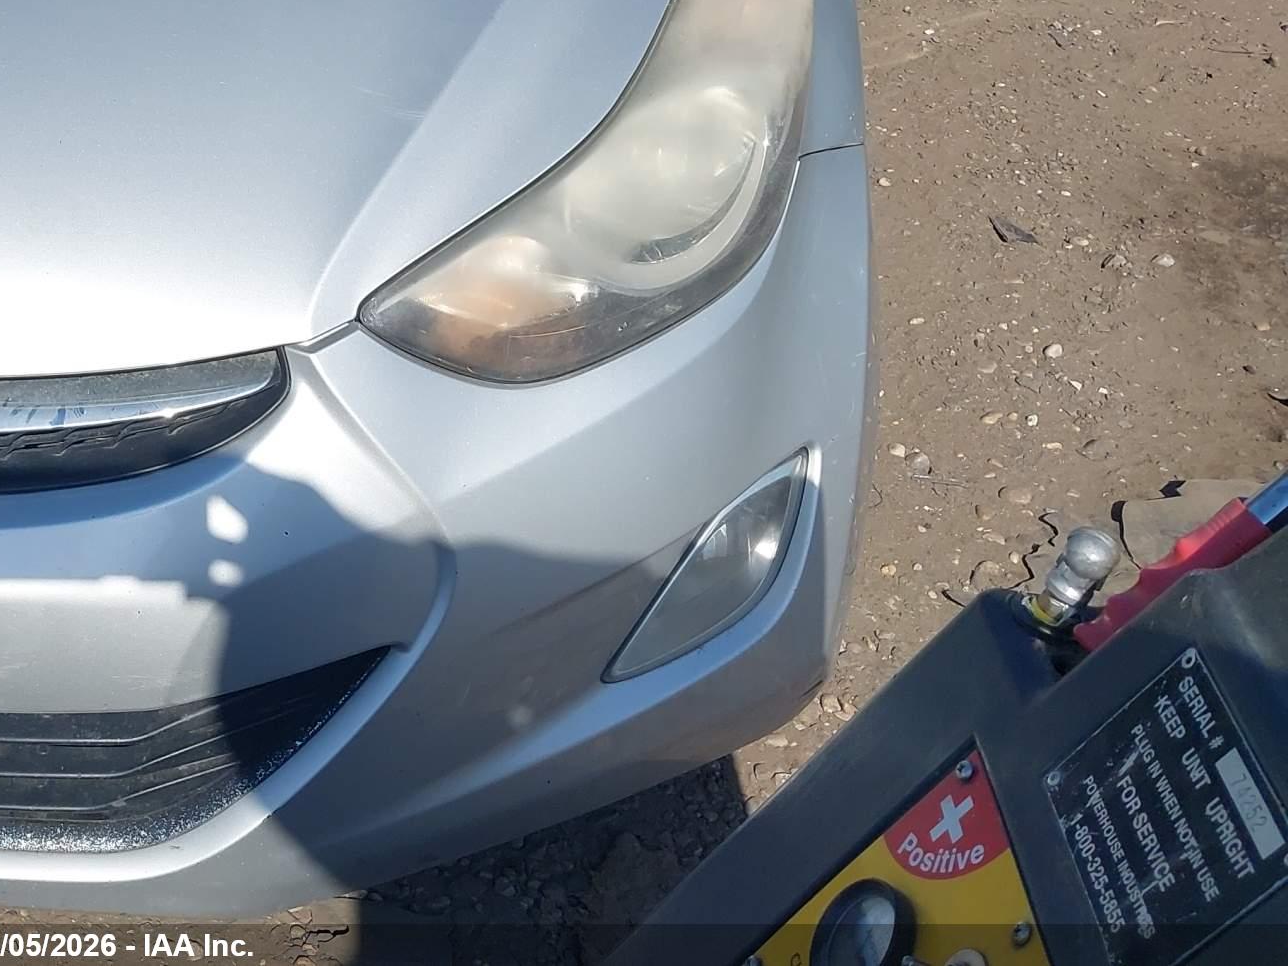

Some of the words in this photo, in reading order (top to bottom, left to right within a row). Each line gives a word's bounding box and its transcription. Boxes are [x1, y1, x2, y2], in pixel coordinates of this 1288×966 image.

[1178, 676, 1216, 738] SERIAL
[1208, 736, 1224, 750] #
[1083, 775, 1125, 862] POWERHOUSE
[1117, 775, 1141, 815] FOR
[1132, 812, 1176, 892] SERVICE
[1131, 724, 1155, 764] PLUG
[1147, 760, 1163, 779] IN
[1155, 775, 1182, 821] WHEN
[1175, 818, 1199, 852] NOT
[1197, 865, 1220, 902] USE
[1154, 694, 1186, 739] KEEP
[1181, 747, 1211, 790] UNIT
[1205, 797, 1255, 879] UPRIGHT
[897, 832, 985, 873] Positive
[1070, 813, 1126, 933] 1-800-325-5855
